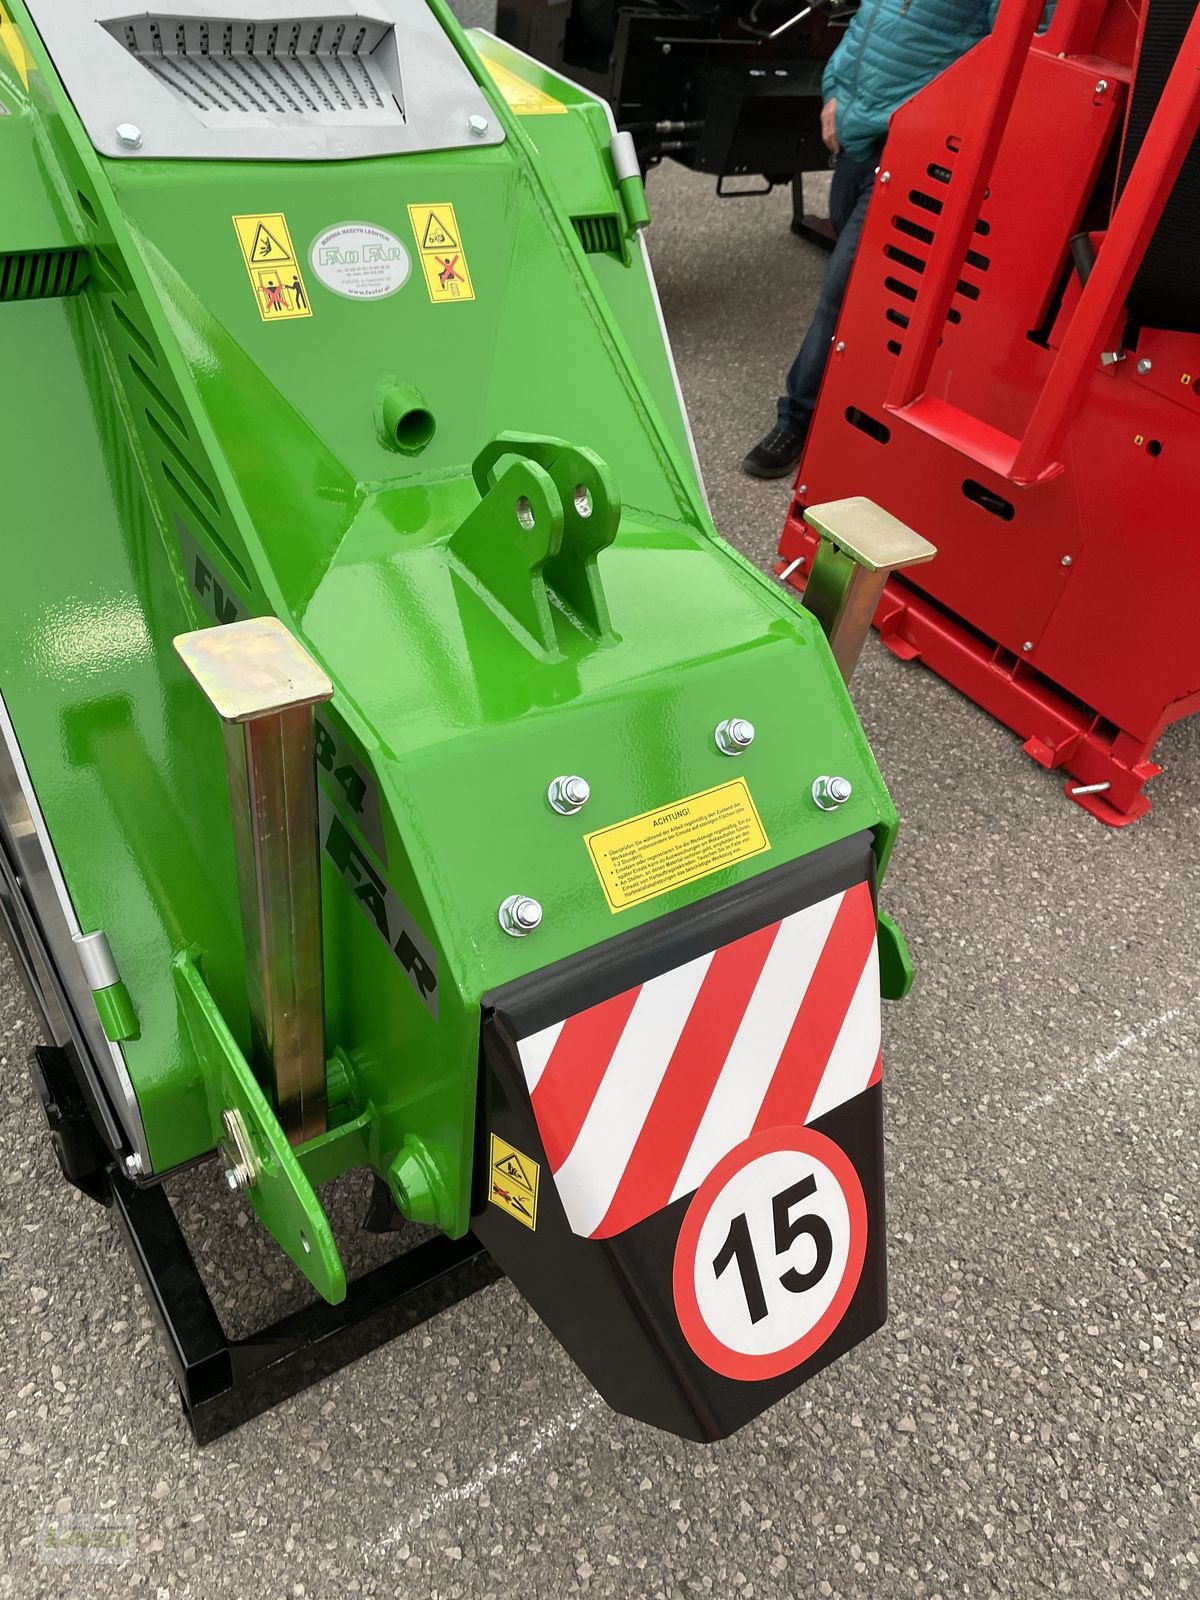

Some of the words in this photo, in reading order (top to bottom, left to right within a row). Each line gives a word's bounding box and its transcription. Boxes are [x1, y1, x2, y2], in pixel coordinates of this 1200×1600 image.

[608, 843, 634, 856] Überprüfen
[643, 832, 662, 842] während
[670, 824, 683, 832] Arbeit
[684, 815, 707, 826] regelmäßig
[716, 804, 733, 814] Zustand
[638, 837, 667, 851] insbesondere
[675, 828, 691, 837] Einsatz
[699, 817, 718, 827] steinigen
[718, 811, 735, 819] Flächen
[653, 808, 690, 827] ACHTUNG!
[615, 863, 635, 873] Ersetzen
[647, 847, 674, 861] regenerieren
[690, 832, 713, 844] Werkzeuge
[617, 871, 632, 879] später
[632, 865, 647, 873] Ersatz
[665, 844, 700, 860] Auswaschungen
[622, 882, 639, 891] Einsatz
[697, 850, 717, 860] Tauschen
[651, 864, 665, 873] denen
[665, 857, 683, 867] Material
[683, 850, 701, 860] verloren
[685, 859, 711, 872] beschädigte
[712, 851, 732, 861] Werkzeug
[324, 814, 437, 1001] FAR
[712, 1173, 833, 1325] 15
